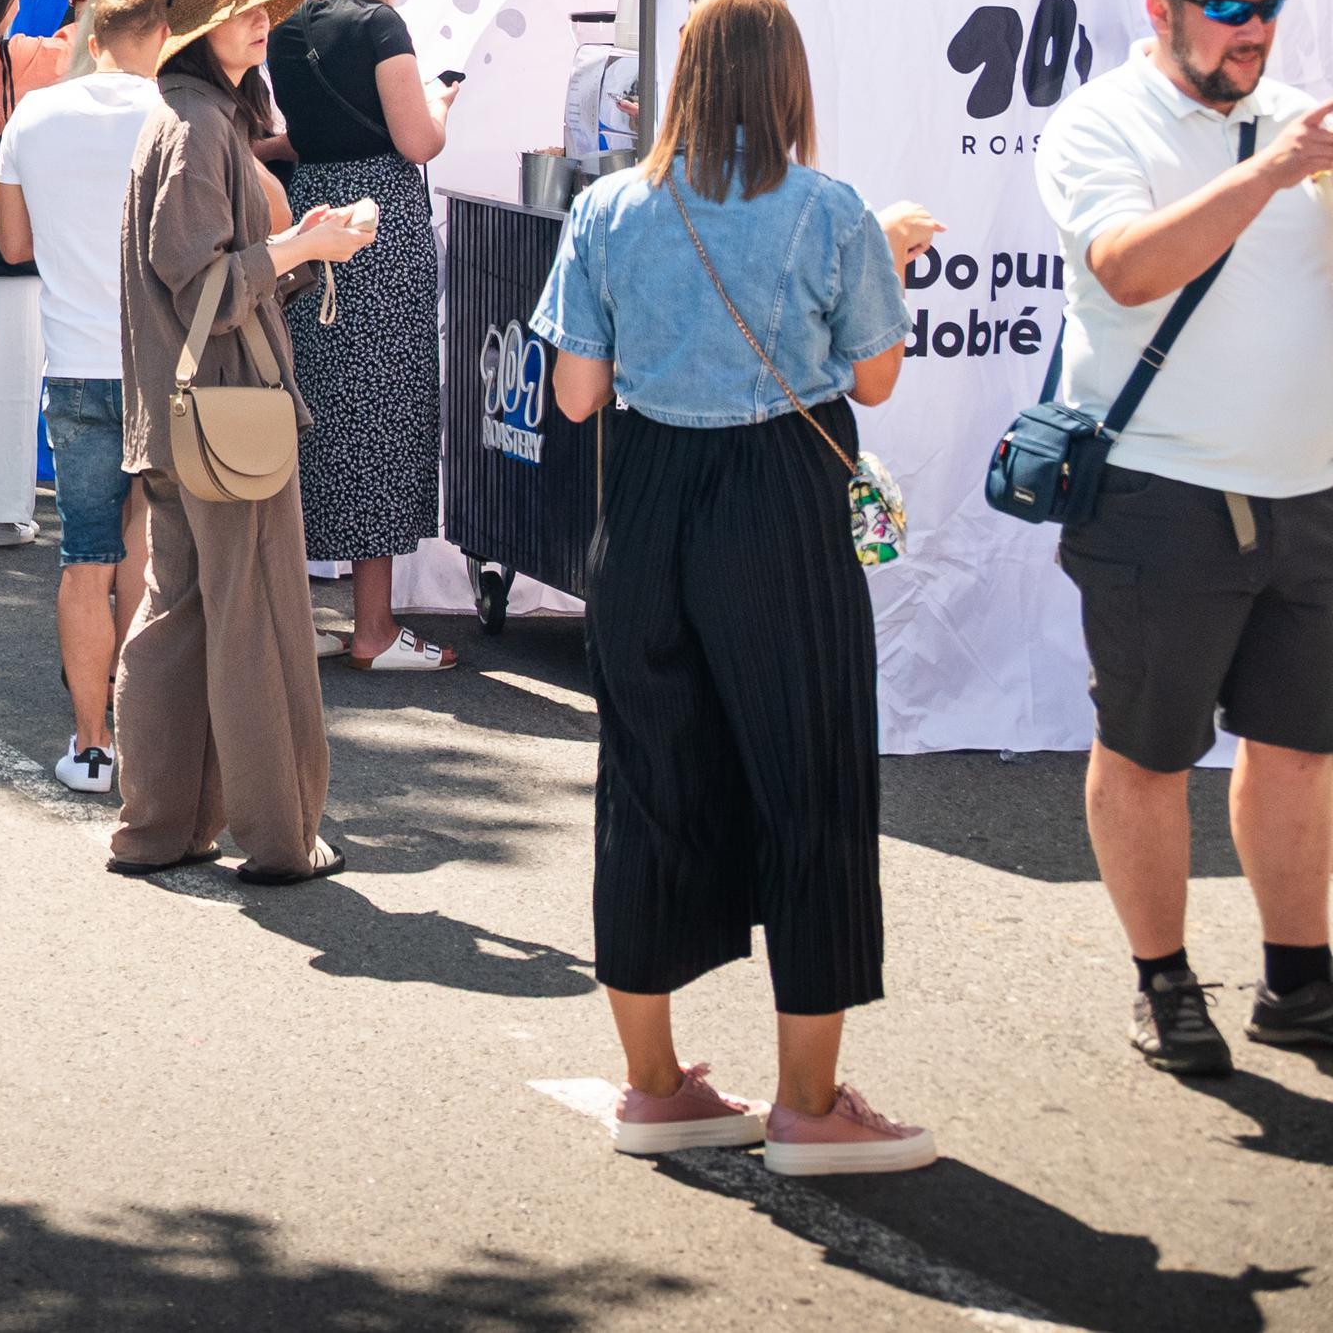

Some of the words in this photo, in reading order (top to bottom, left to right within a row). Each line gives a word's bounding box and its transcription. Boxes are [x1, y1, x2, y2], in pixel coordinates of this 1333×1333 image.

[961, 134, 1042, 157] ROAS
[903, 244, 980, 291] Do
[902, 306, 1043, 359] dobré
[481, 415, 546, 465] ROASTERY
